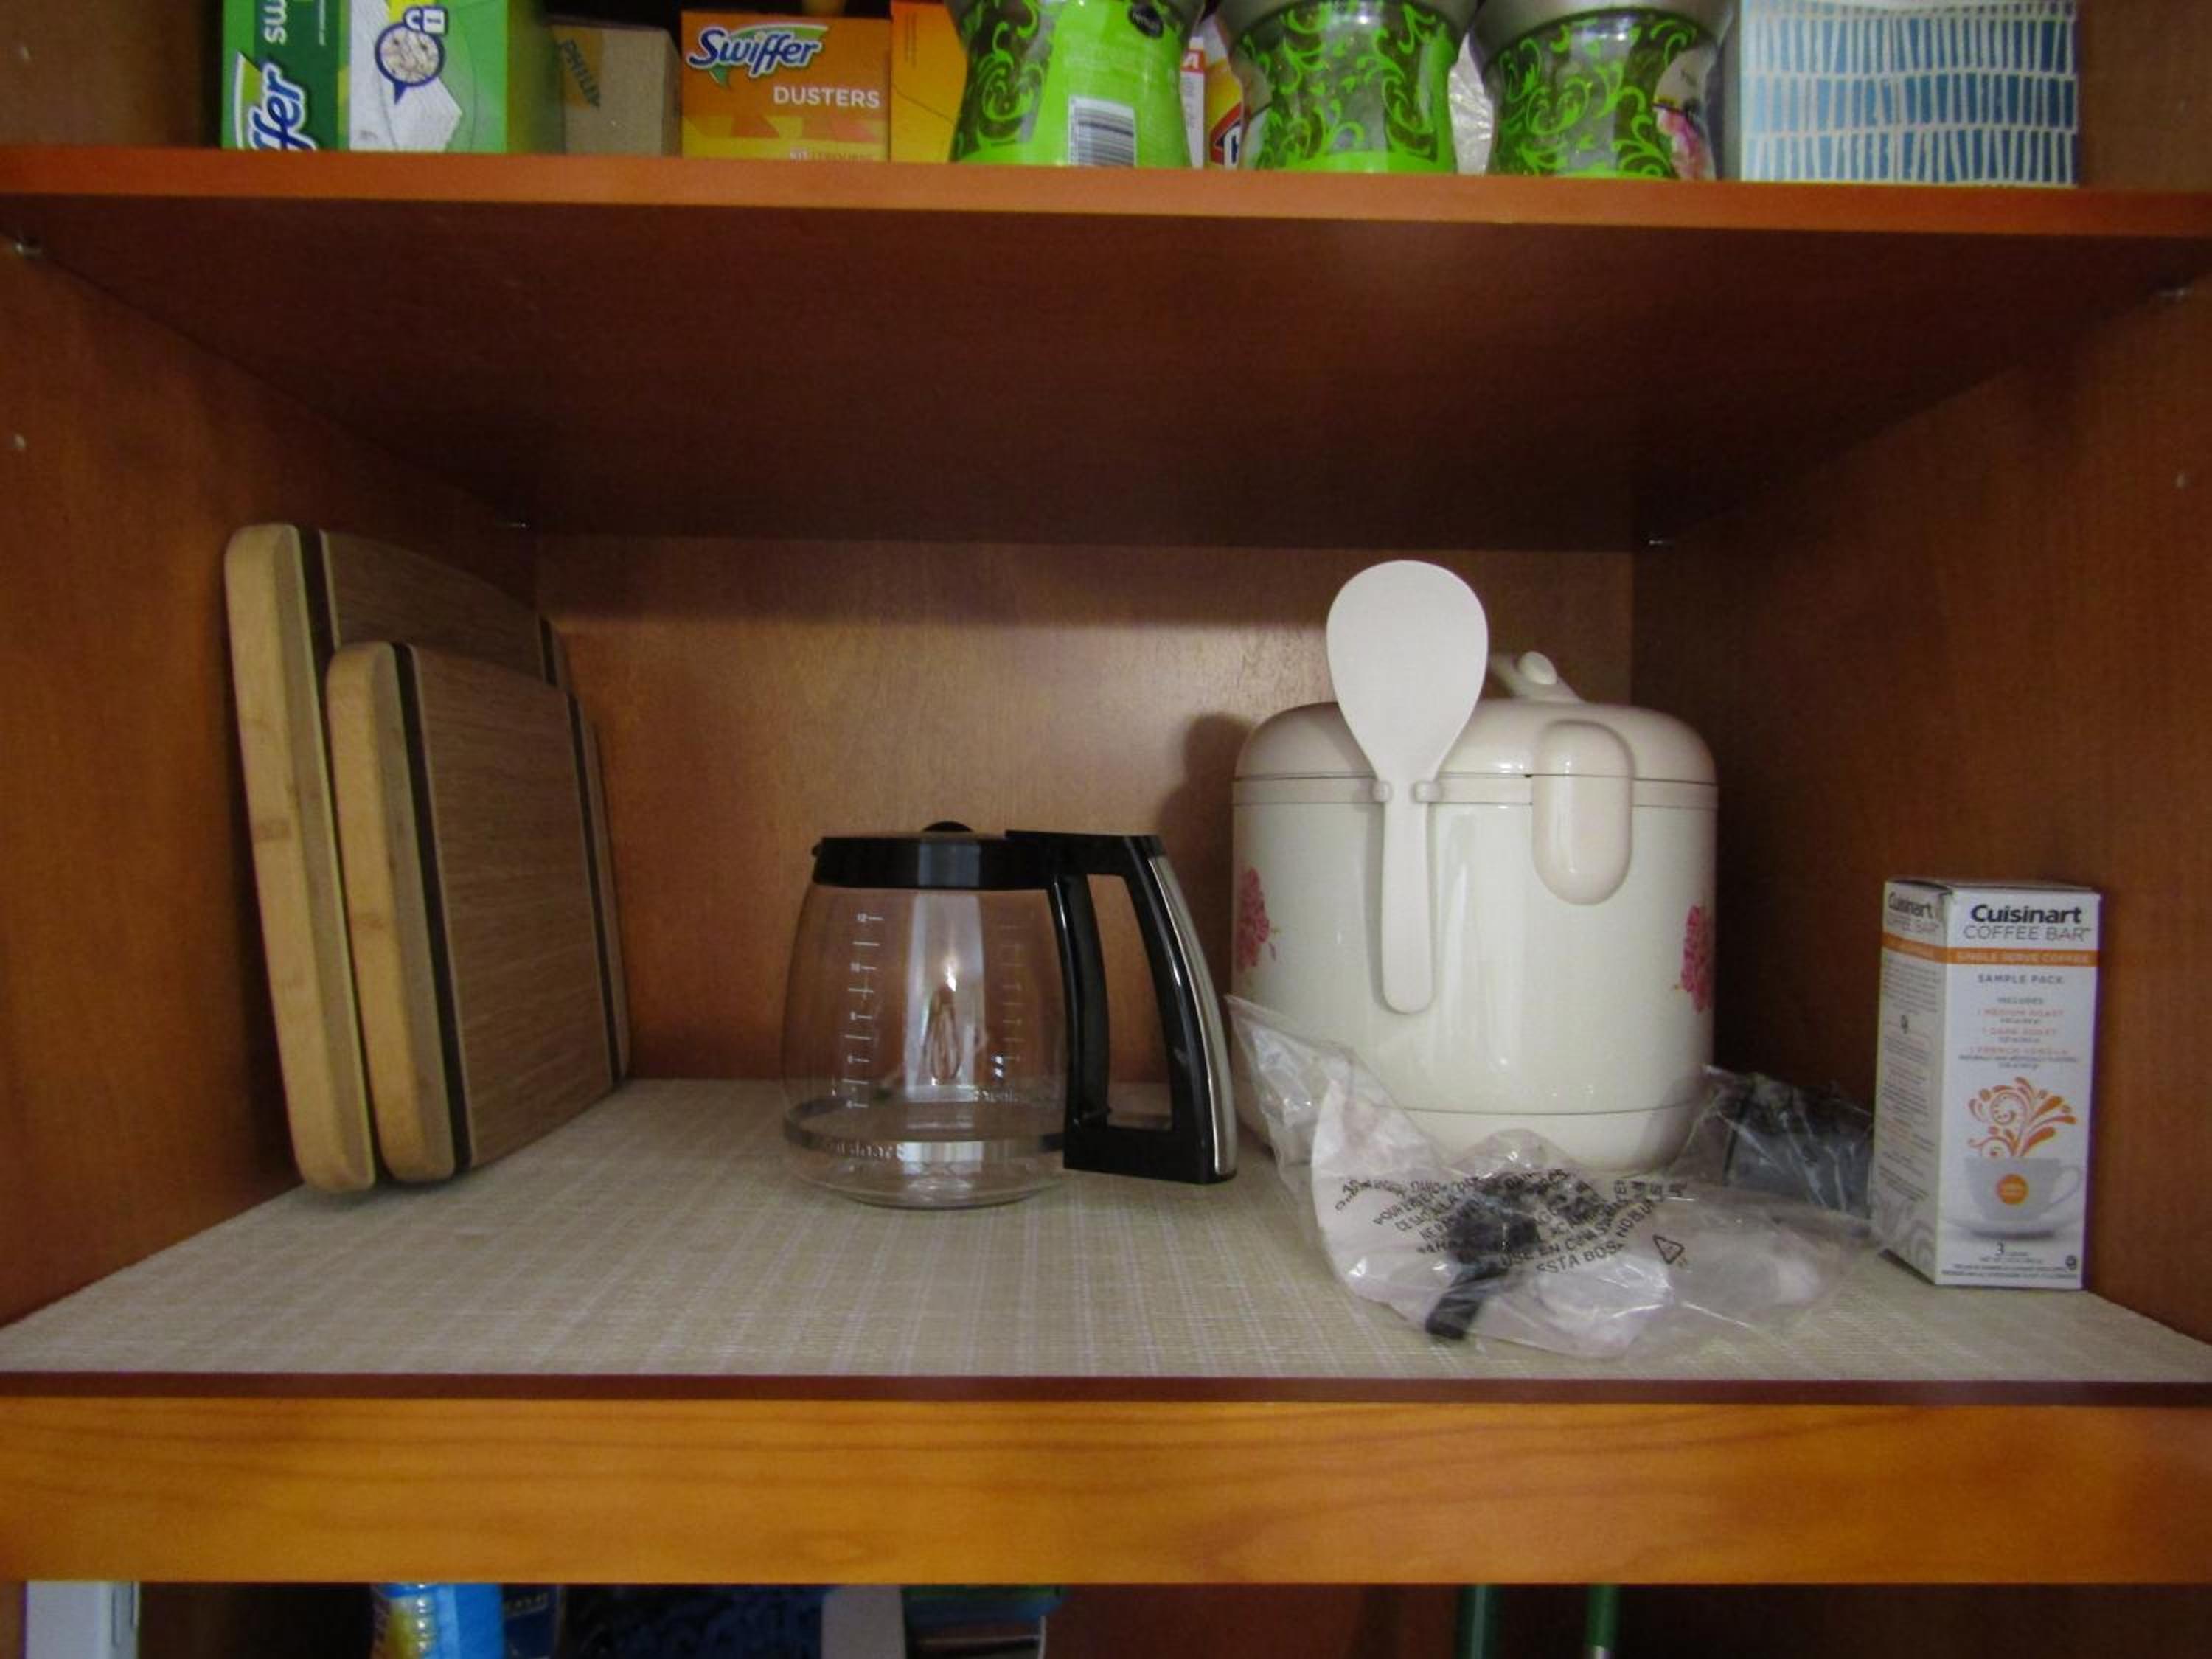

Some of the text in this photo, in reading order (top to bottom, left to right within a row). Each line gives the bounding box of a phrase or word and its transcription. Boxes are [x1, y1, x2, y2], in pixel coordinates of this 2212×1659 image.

[688, 27, 821, 75] Swiffer
[773, 85, 881, 109] DUSTERS
[1970, 904, 2082, 923] Cuisinart
[1963, 925, 2039, 941] COFFEE
[1978, 974, 2065, 984] SAMPLE PACK
